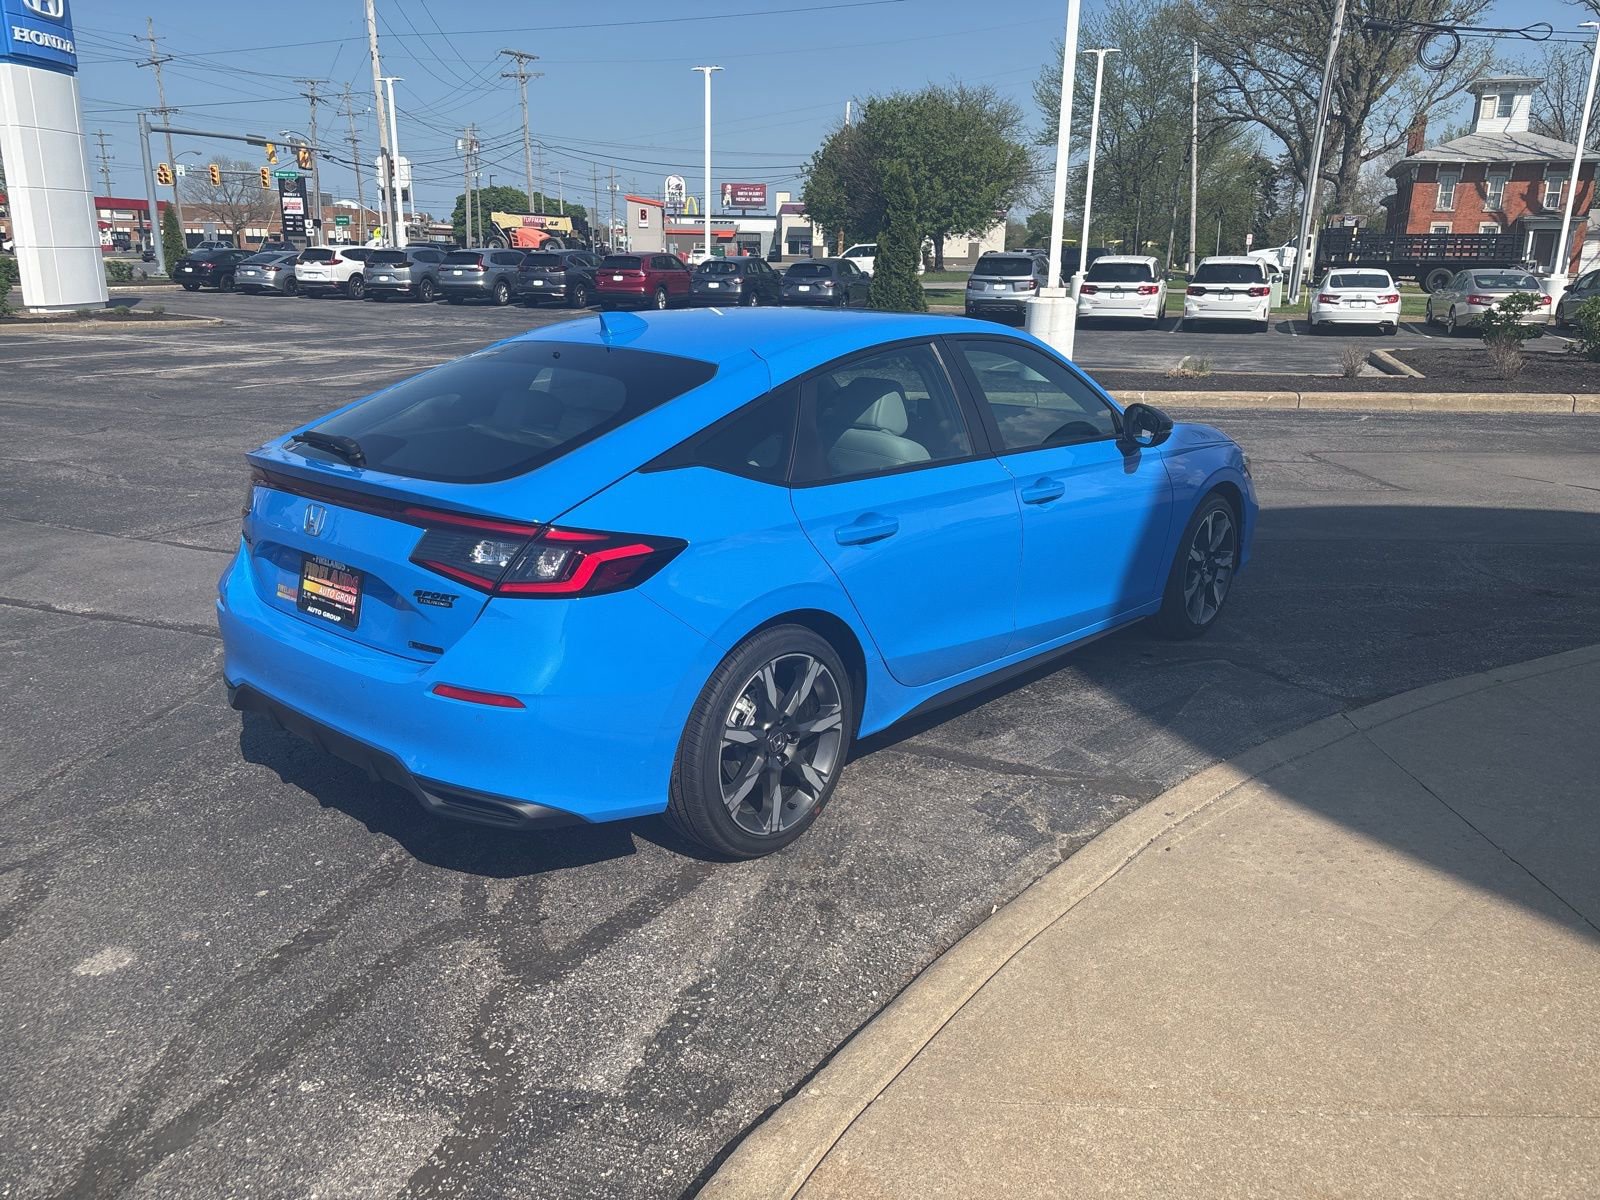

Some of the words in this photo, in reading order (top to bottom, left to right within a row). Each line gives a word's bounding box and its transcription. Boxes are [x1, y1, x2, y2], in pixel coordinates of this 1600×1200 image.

[11, 25, 76, 54] HONDA
[640, 209, 647, 220] B
[319, 586, 335, 599] AUTO
[413, 590, 461, 602] SPORT
[306, 605, 322, 616] AUTO
[322, 611, 342, 622] GROUP
